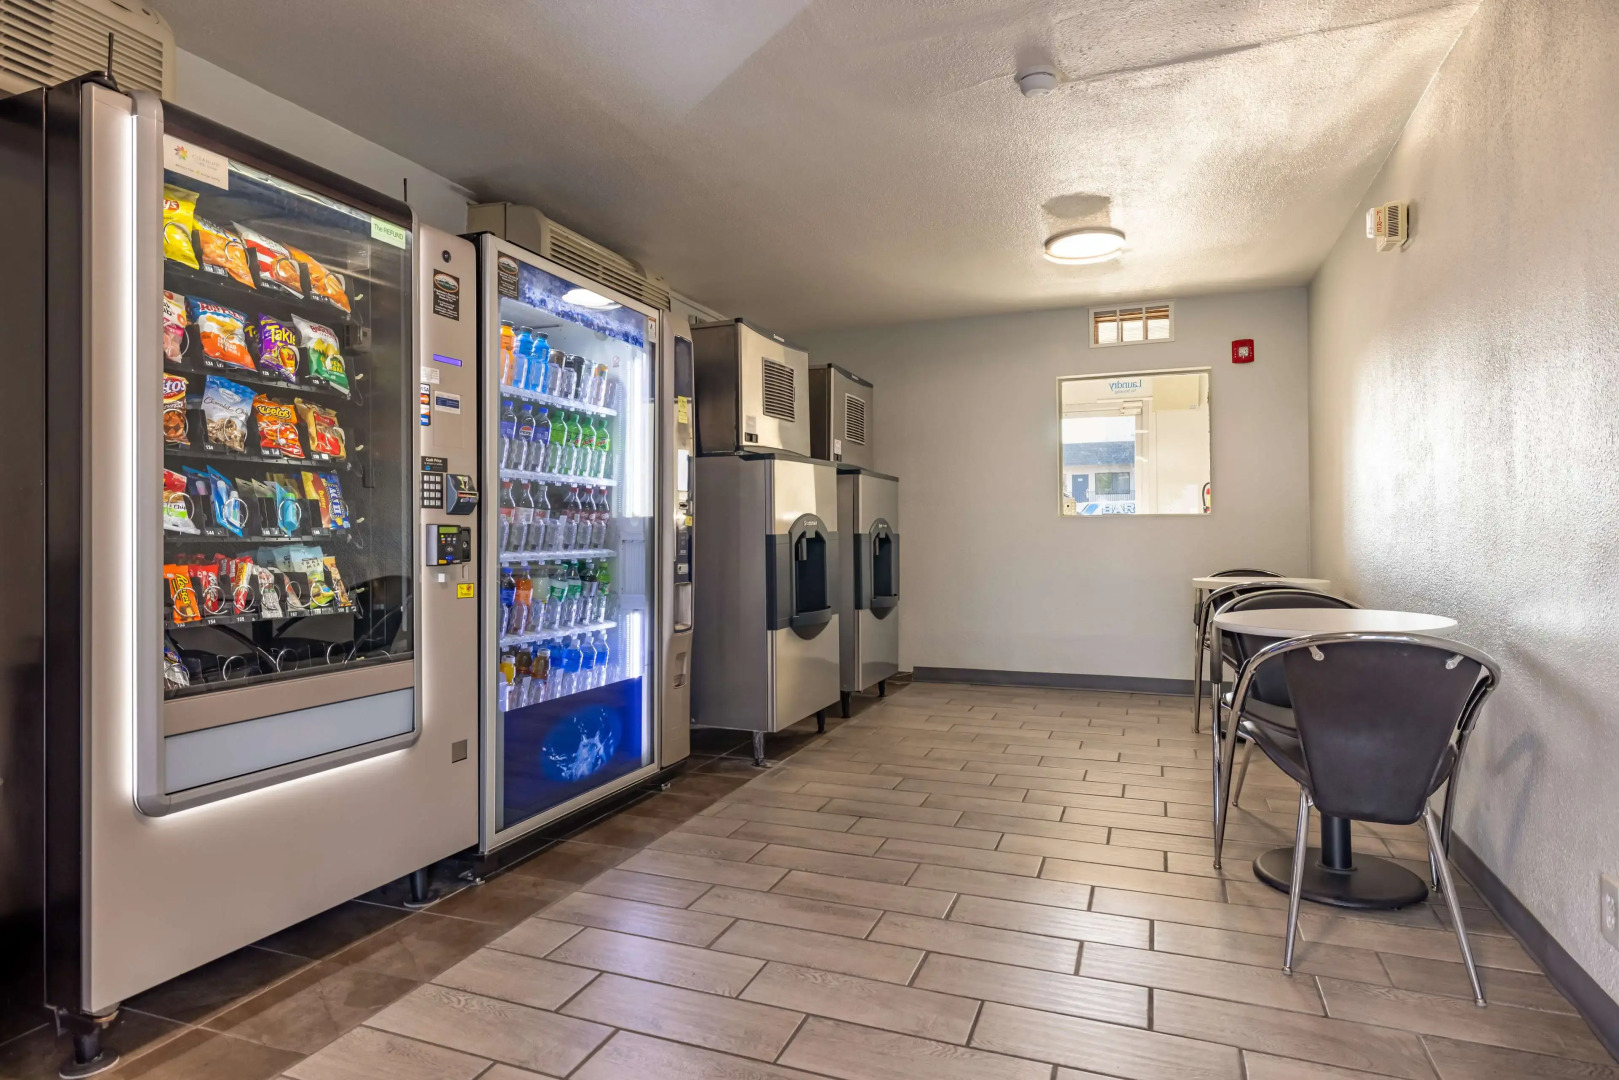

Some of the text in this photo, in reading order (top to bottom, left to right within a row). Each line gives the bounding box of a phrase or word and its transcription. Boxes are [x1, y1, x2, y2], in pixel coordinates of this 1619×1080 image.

[374, 223, 404, 241] The REFUND
[163, 379, 186, 394] tos
